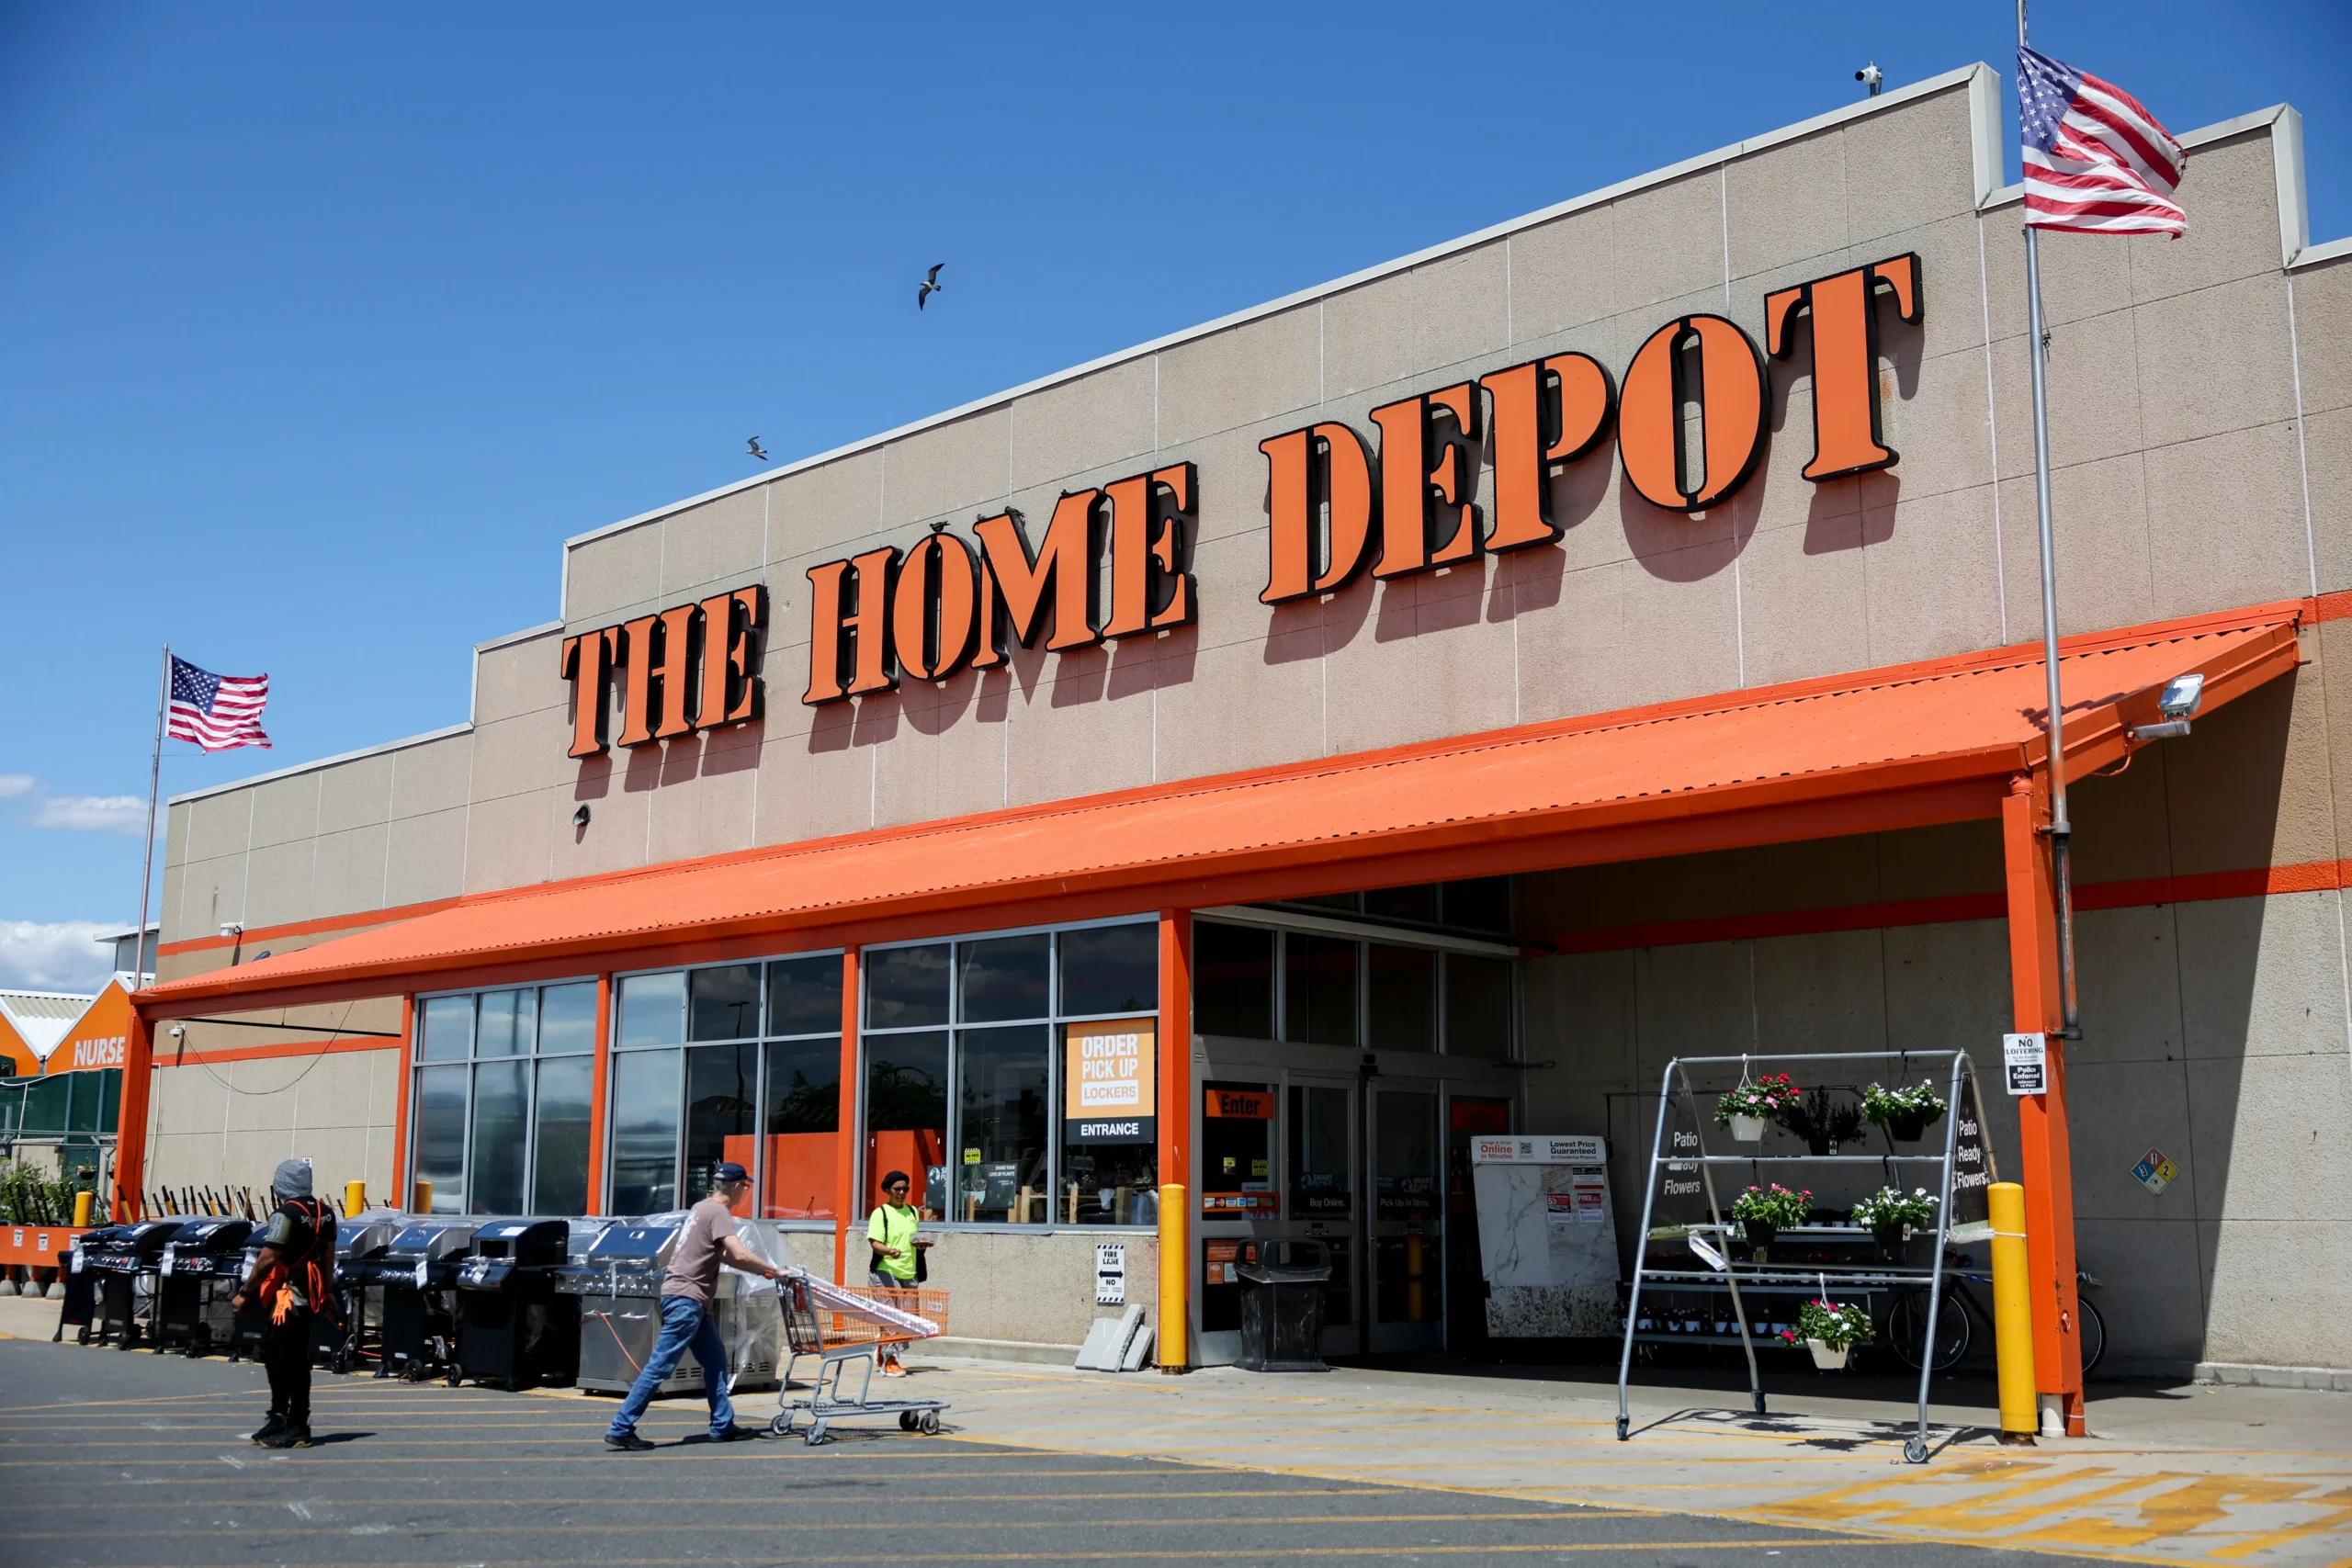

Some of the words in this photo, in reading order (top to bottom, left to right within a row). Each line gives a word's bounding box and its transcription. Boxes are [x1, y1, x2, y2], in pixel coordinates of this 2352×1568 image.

[561, 584, 768, 759] THE
[802, 461, 1197, 706] HOME
[1259, 252, 1924, 606] DEPOT
[74, 1036, 126, 1066] NURSE
[1081, 1033, 1138, 1058] ORDER
[2018, 1039, 2033, 1047] NO
[1082, 1059, 1115, 1079] PICK
[1119, 1058, 1138, 1077] UP
[1084, 1086, 1136, 1100] LOCKERS
[1221, 1094, 1261, 1115] Enter
[1080, 1122, 1139, 1136] ENTRANCE
[1959, 1119, 1977, 1136] Patio
[1674, 1132, 1698, 1147] Patio
[1481, 1145, 1512, 1153] Online
[1958, 1144, 1981, 1164] Ready
[2164, 1166, 2169, 1176] 2
[1664, 1179, 1701, 1195] Flowers
[1957, 1171, 1986, 1189] Flowers
[1309, 1198, 1322, 1208] Buy
[1323, 1198, 1345, 1207] Online.
[1380, 1198, 1394, 1207] Pick
[1395, 1198, 1404, 1208] Up
[1405, 1198, 1411, 1206] In
[1412, 1198, 1430, 1207] Store.
